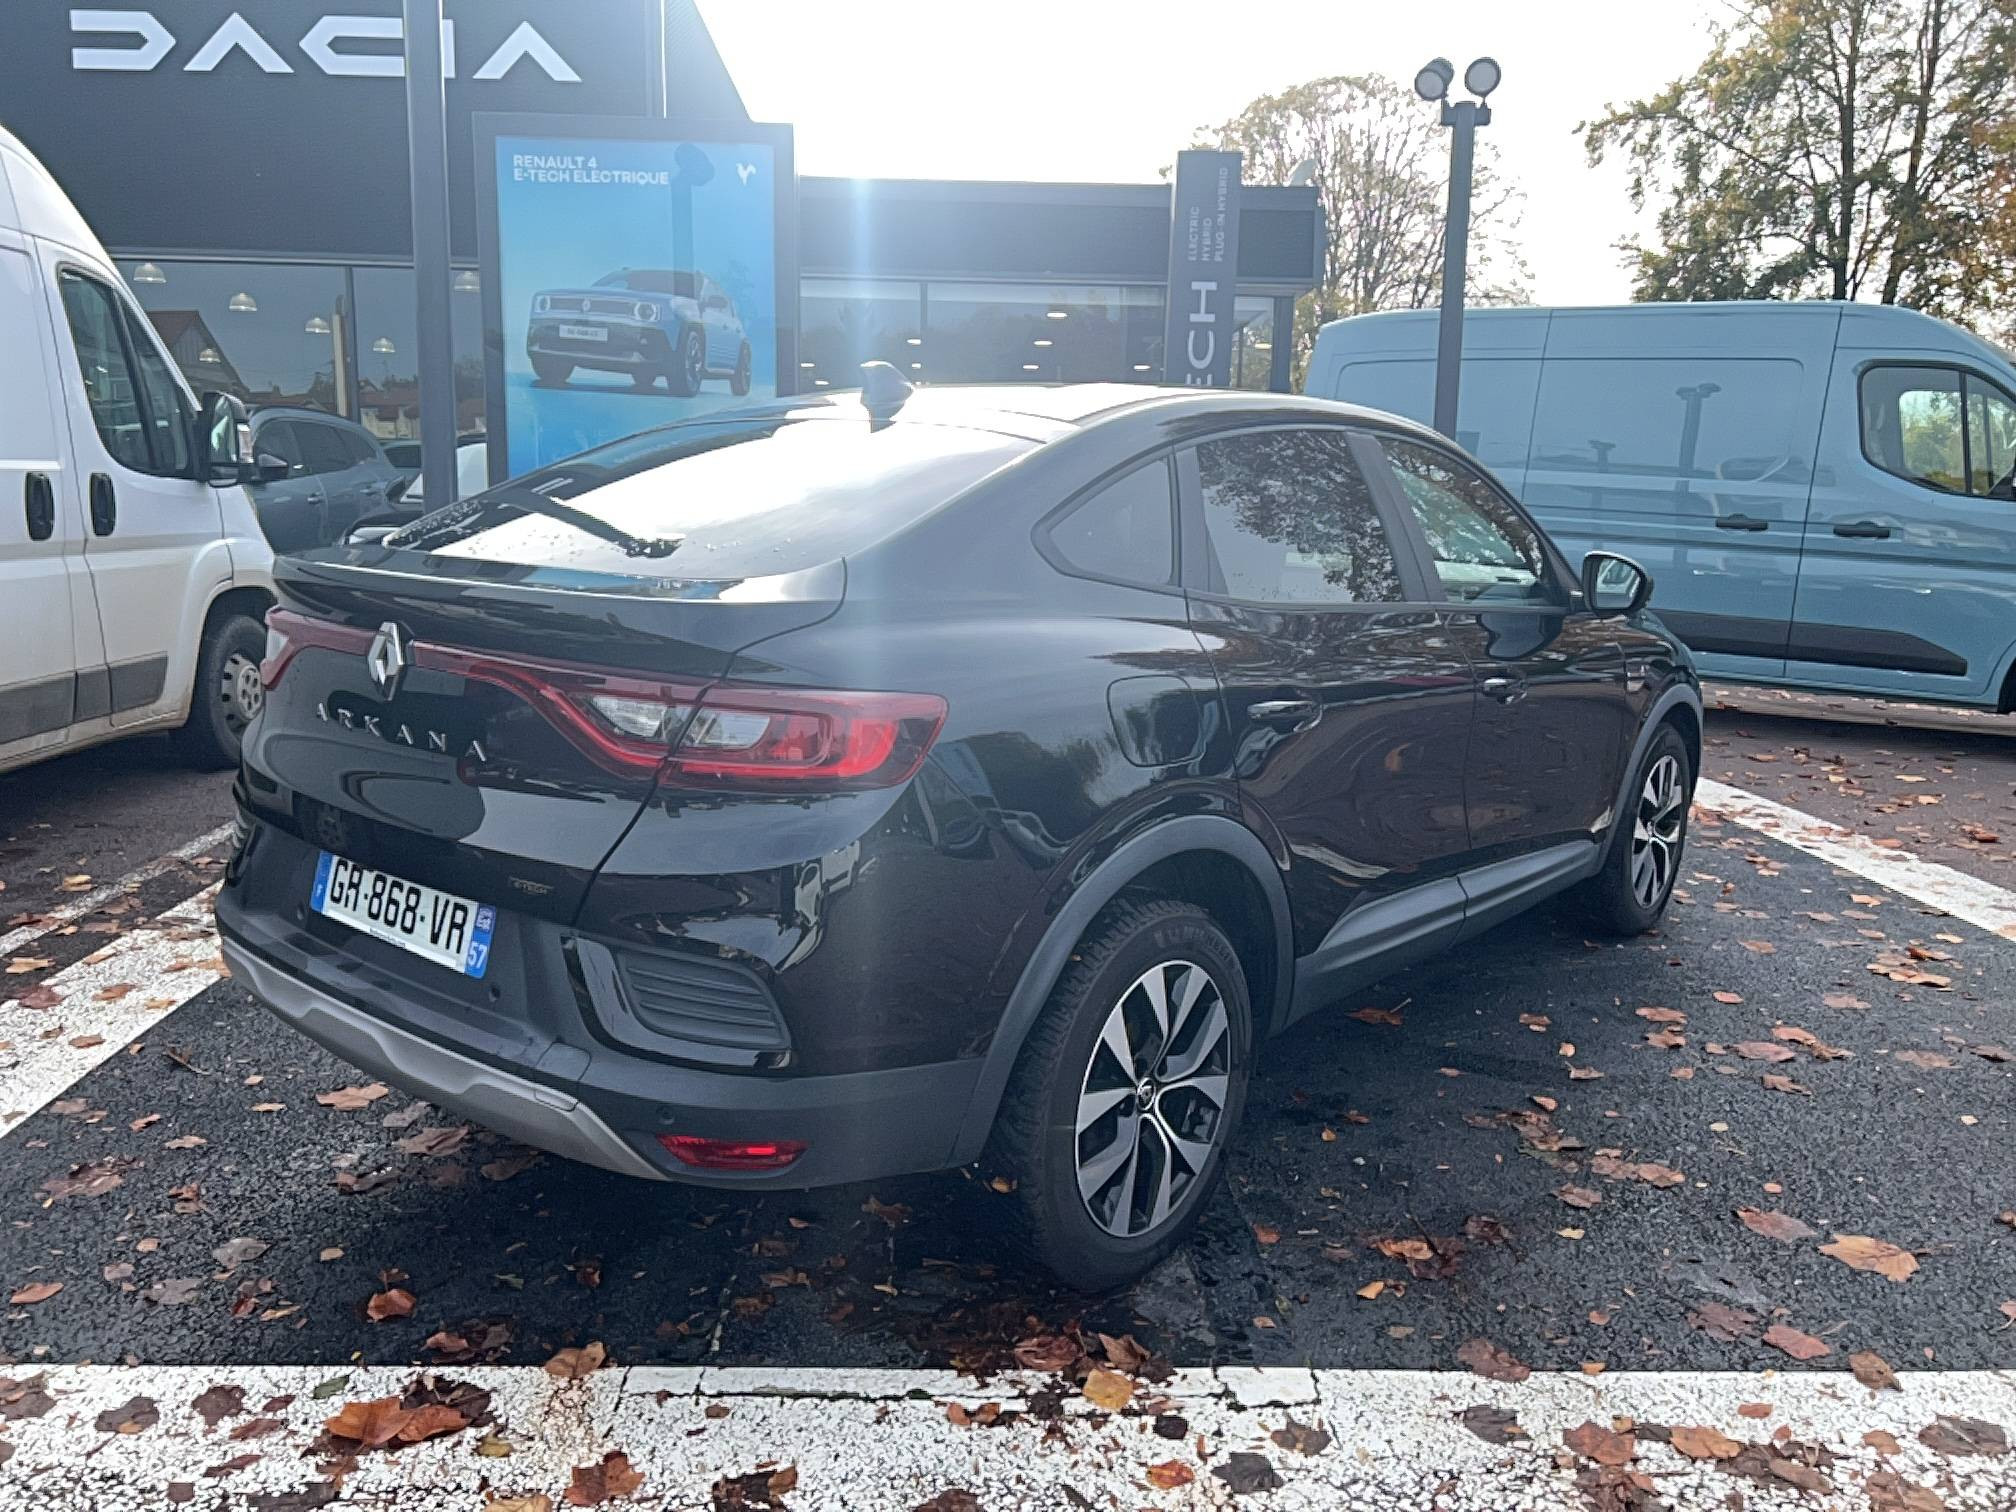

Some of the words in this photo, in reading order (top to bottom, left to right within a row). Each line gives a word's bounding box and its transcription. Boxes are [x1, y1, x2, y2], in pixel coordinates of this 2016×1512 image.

[513, 154, 586, 169] RENAULT
[587, 155, 597, 169] 4
[513, 168, 569, 183] E-TECH
[573, 169, 670, 185] ELECTRIQUE
[1188, 206, 1200, 261] ELECTRIC
[1201, 217, 1212, 262] HYBRID
[317, 702, 487, 762] ARKANA
[330, 857, 469, 954] GR-868-VR
[467, 941, 488, 969] 57
